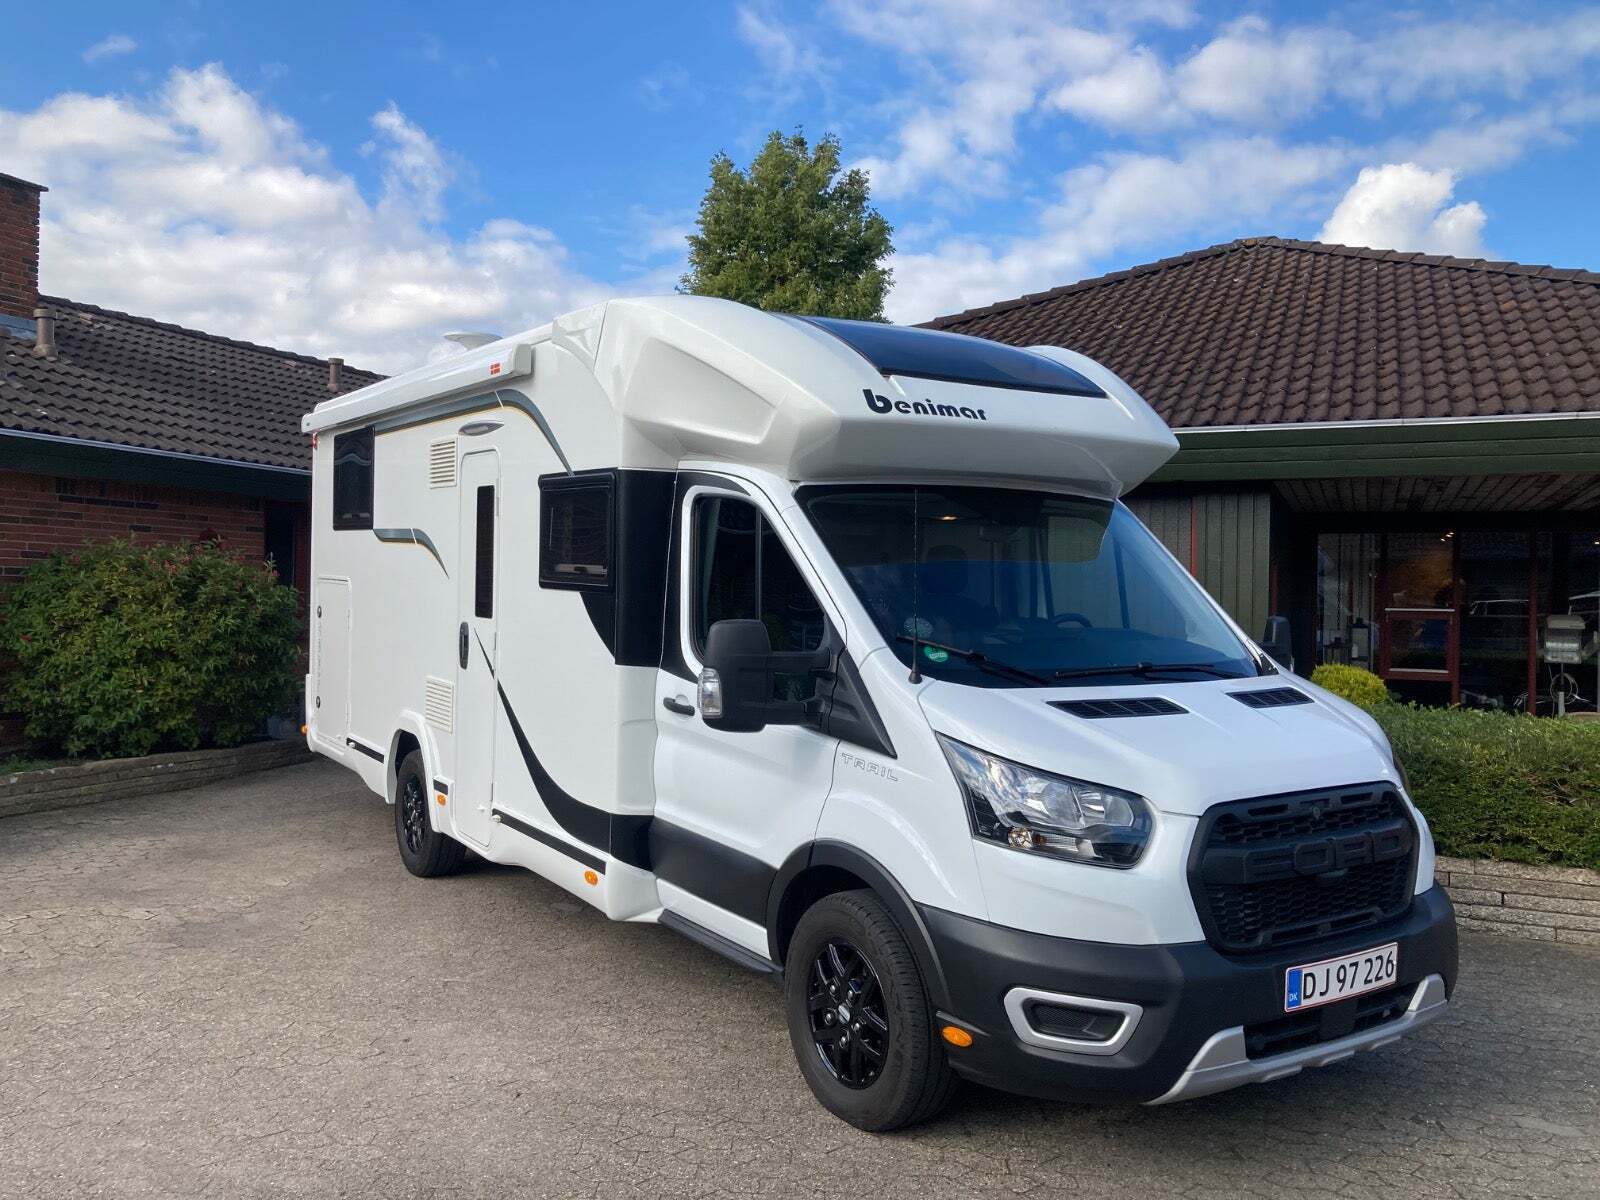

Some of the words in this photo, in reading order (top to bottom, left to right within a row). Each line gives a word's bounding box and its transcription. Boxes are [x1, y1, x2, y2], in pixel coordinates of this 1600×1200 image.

[862, 388, 987, 421] benimar
[841, 752, 898, 782] TRAIL
[1303, 968, 1330, 1000] DJ
[1336, 964, 1359, 993] 97
[1363, 951, 1395, 985] 226
